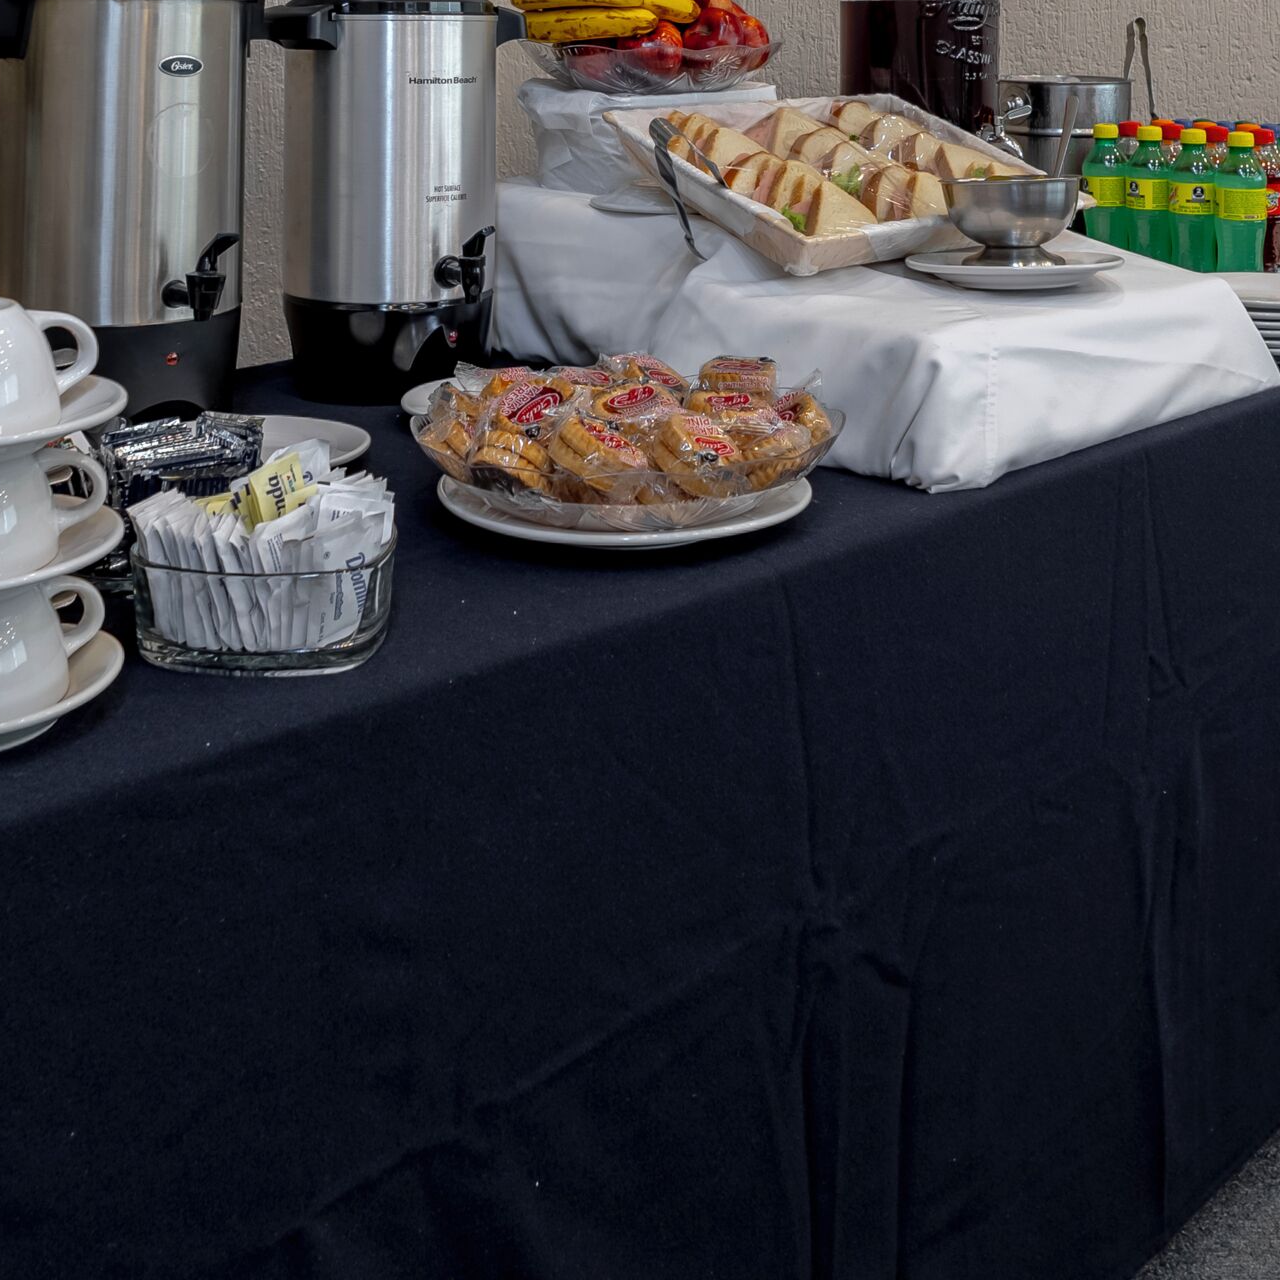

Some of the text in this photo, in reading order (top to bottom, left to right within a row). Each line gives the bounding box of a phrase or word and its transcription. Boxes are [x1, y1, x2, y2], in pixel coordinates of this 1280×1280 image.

[170, 60, 194, 72] Oster
[408, 76, 477, 85] Hamilton Beach
